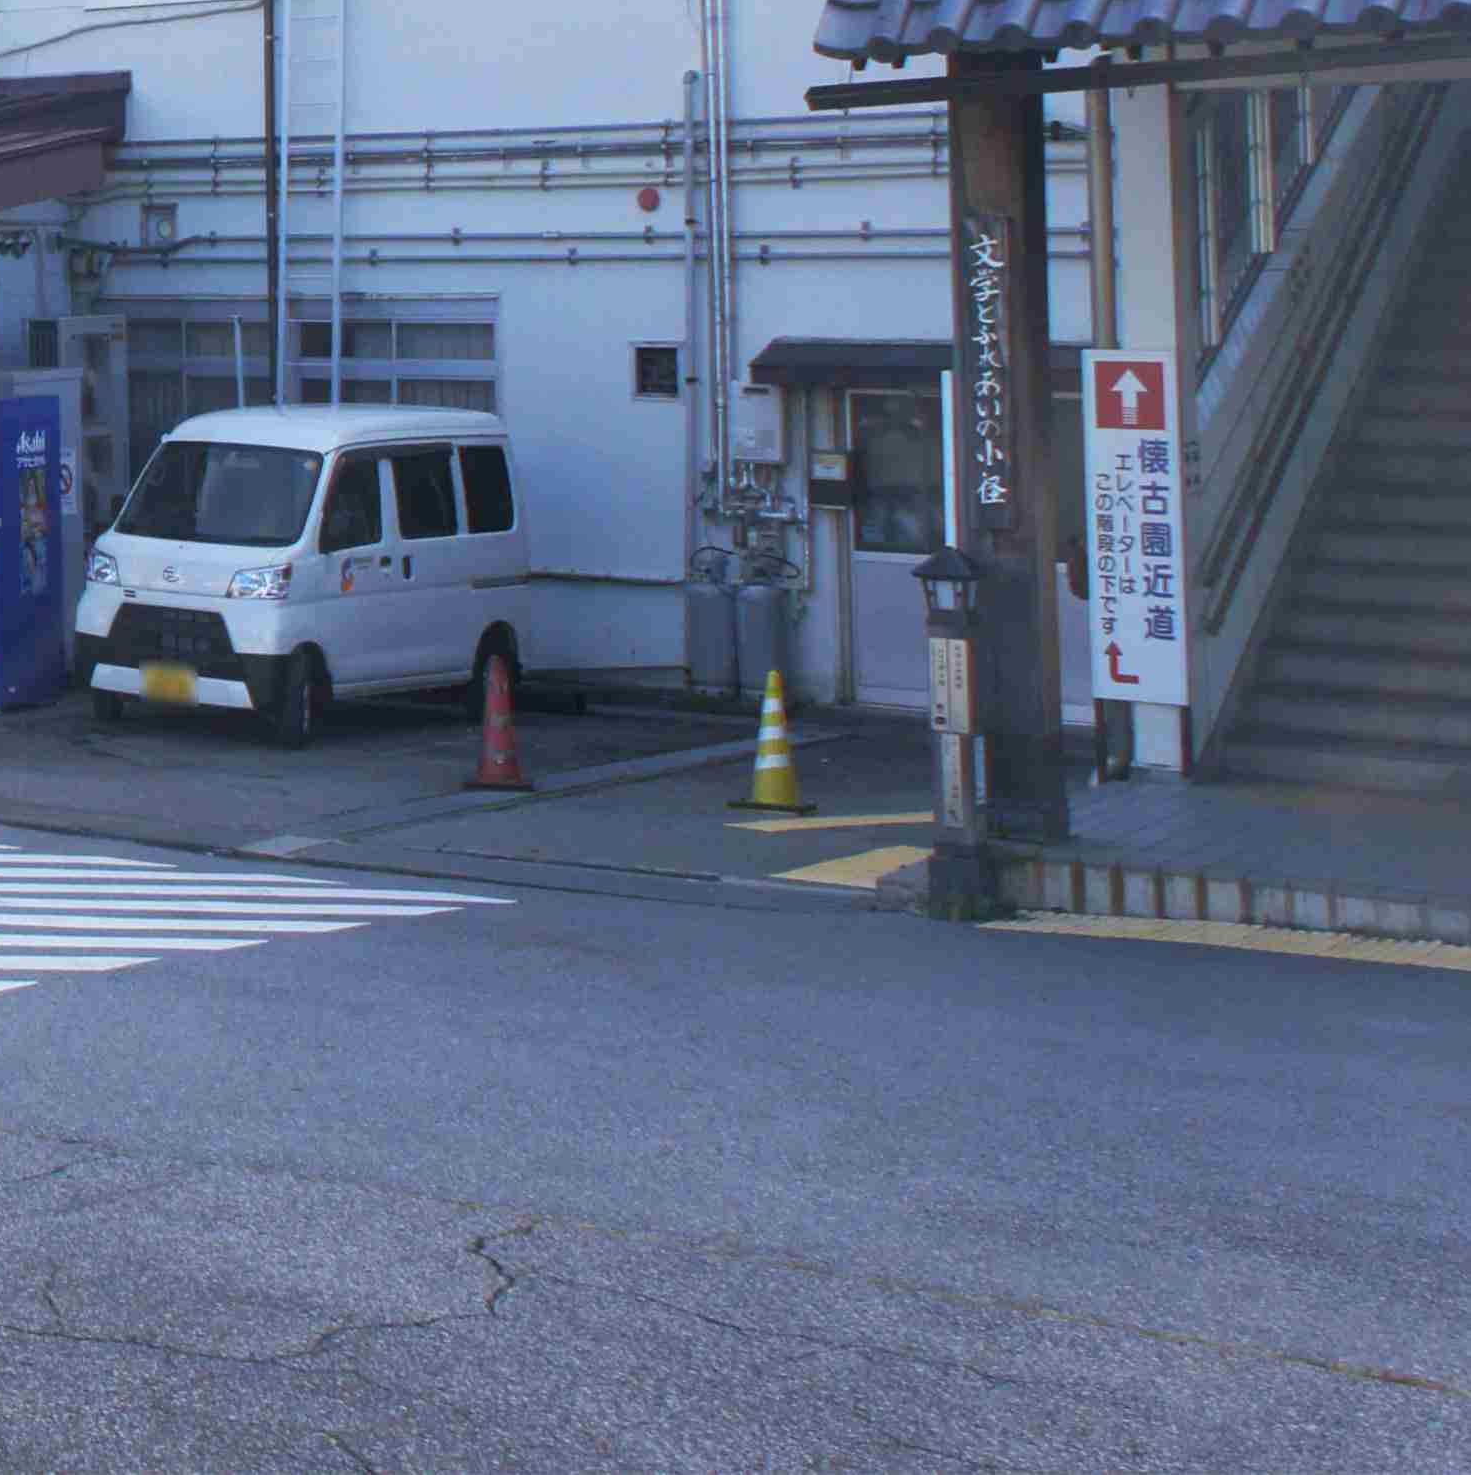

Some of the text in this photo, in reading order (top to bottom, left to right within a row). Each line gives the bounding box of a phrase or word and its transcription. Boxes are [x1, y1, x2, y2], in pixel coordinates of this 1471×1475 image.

[1096, 473, 1117, 636] この階段の下です
[1115, 453, 1137, 595] エレベーターは
[1138, 437, 1177, 642] 懐古園近道
